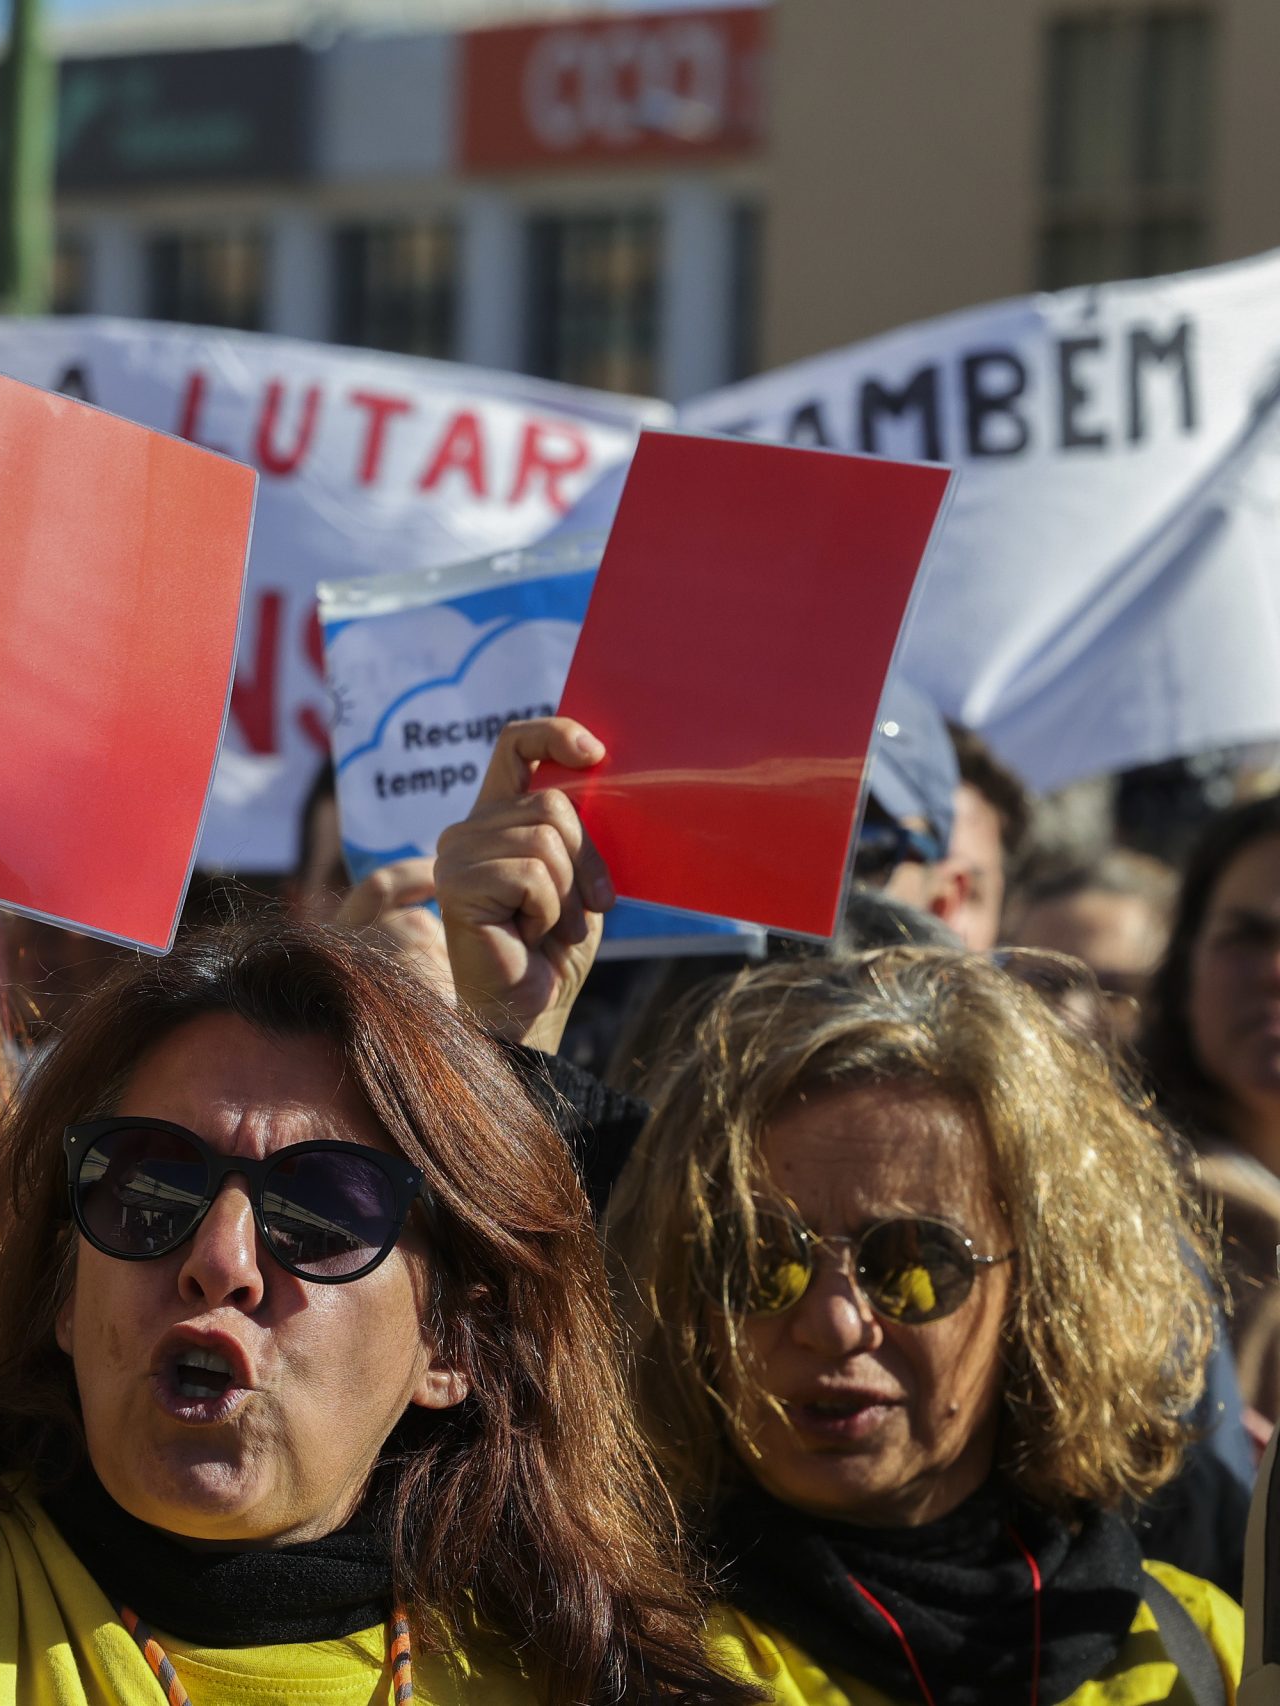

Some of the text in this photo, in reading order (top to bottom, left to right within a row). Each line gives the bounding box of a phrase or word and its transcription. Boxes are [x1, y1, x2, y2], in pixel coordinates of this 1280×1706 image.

[176, 364, 594, 518] LUTAR
[726, 288, 1202, 463] MBÉM
[375, 762, 477, 799] tempo
